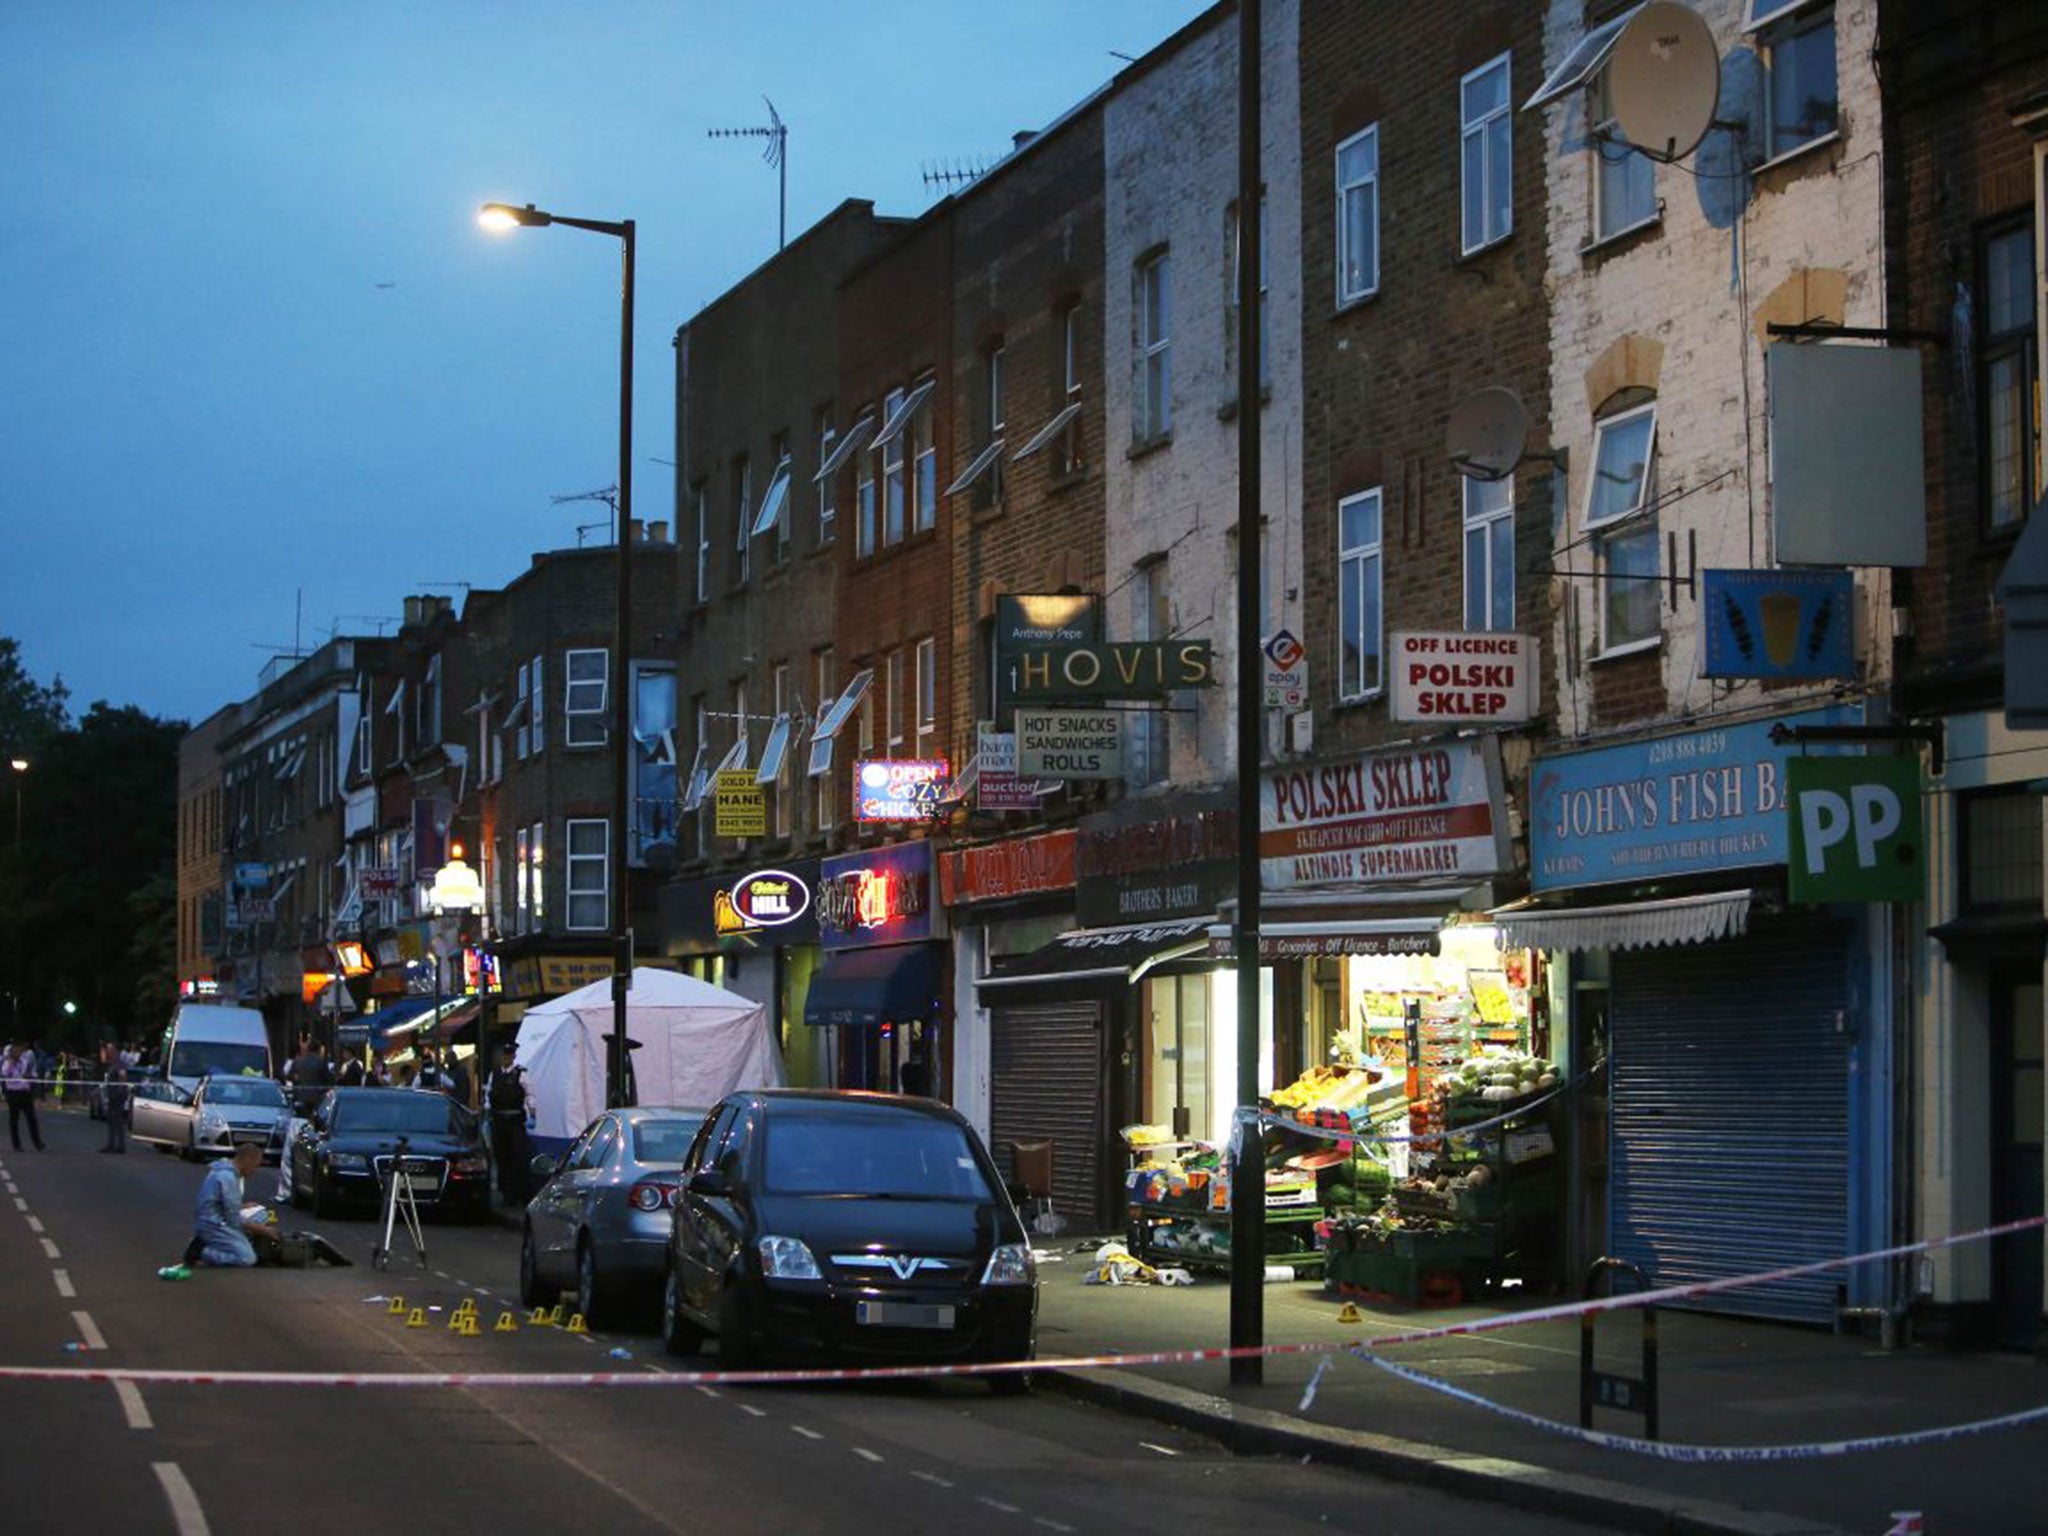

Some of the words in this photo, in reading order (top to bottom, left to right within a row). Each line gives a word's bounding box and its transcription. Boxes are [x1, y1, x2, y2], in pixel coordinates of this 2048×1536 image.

[1057, 627, 1083, 641] Pepe
[1405, 638, 1439, 652] OFF
[1445, 639, 1518, 654] LICENCE
[1023, 646, 1206, 688] HOVIS
[1409, 664, 1514, 687] POLSKI
[1418, 692, 1506, 714] SKLEP
[1025, 718, 1053, 732] HOT
[1058, 718, 1117, 733] SNACKS
[1027, 737, 1117, 750] SANDWICHES
[1042, 755, 1100, 770] ROLLS
[890, 766, 937, 780] OPEN
[888, 781, 942, 801] COZY
[1273, 761, 1366, 823] POLSKI
[1371, 750, 1451, 810] SKLEP
[719, 795, 763, 805] HANE
[1556, 779, 1659, 839] JOHN'S
[1669, 766, 1743, 825] FISH
[1389, 818, 1406, 839] OFF
[1407, 815, 1447, 837] LICENCE
[1799, 784, 1902, 874] PP
[1359, 844, 1459, 877] SUPERMARKET
[752, 896, 790, 914] HILL
[1119, 887, 1161, 913] BROTHERS
[1165, 884, 1198, 909] BAKERY
[1278, 939, 1318, 952] Groceries
[1326, 937, 1341, 951] Off
[1343, 937, 1378, 951] Licence
[1388, 936, 1431, 951] Butchers
